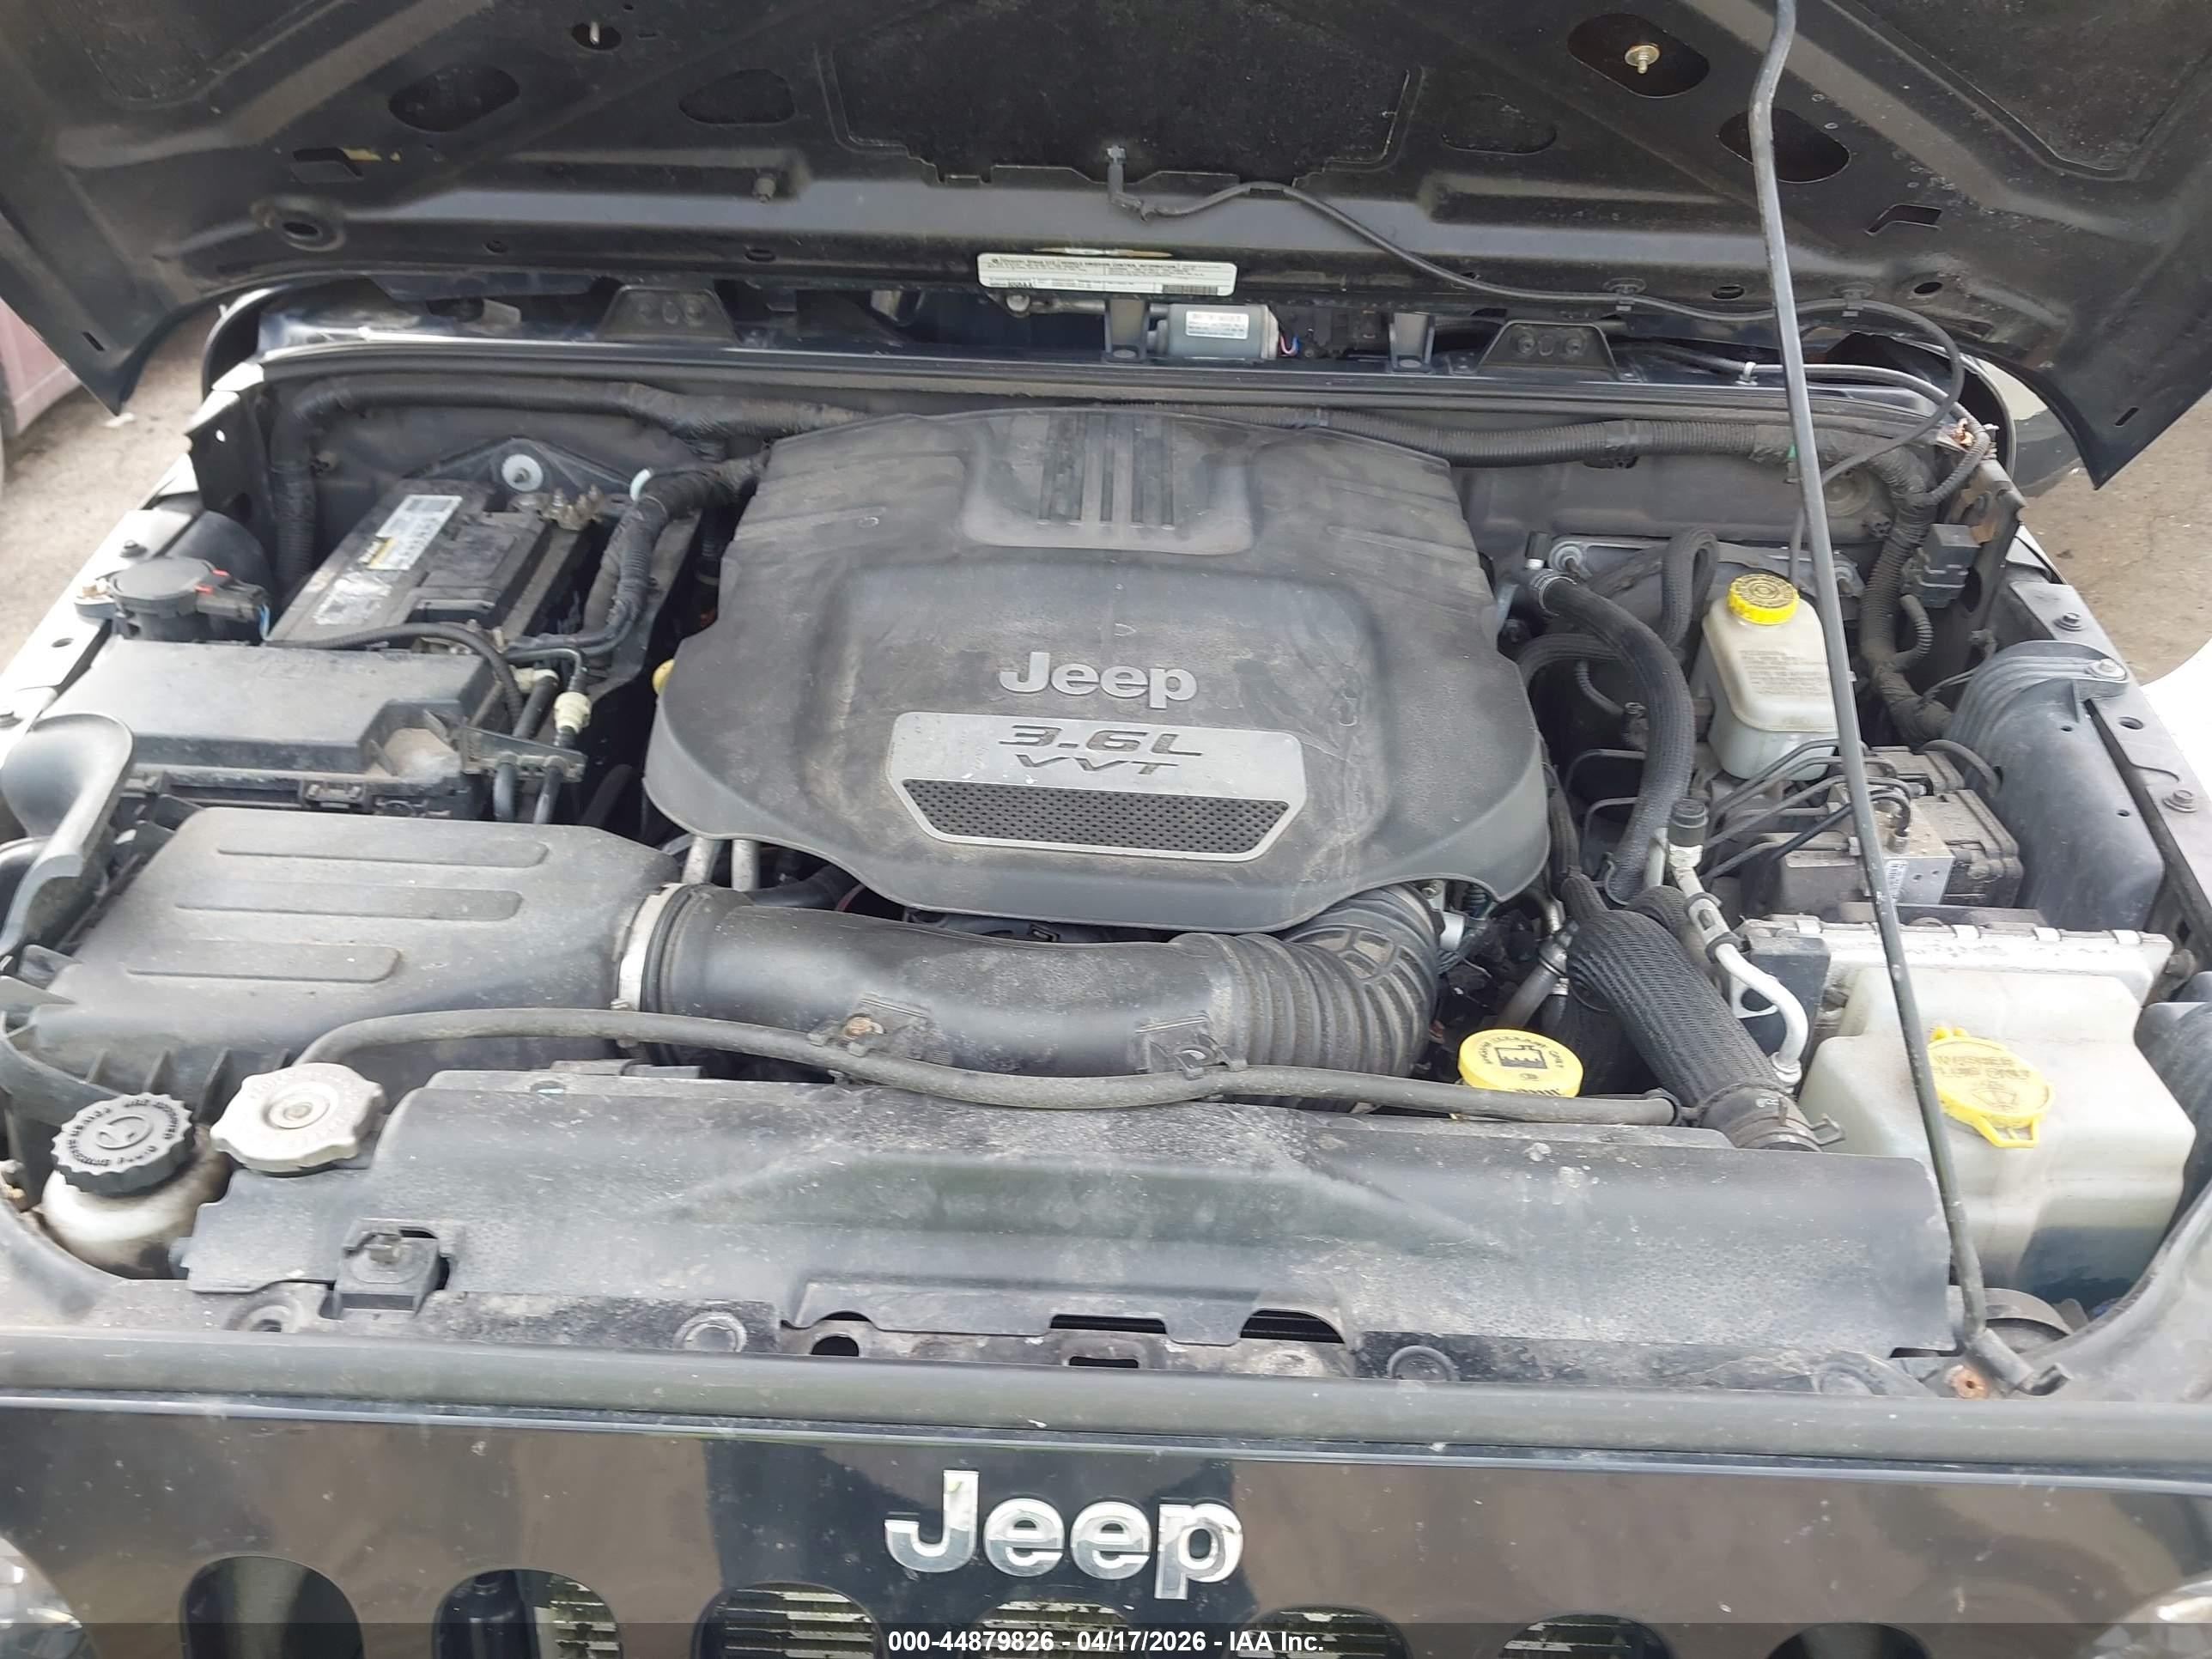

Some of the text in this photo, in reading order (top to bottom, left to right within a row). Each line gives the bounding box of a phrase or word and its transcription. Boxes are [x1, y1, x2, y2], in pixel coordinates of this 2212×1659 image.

[999, 651, 1197, 709] Jeep
[999, 725, 1203, 757] 3.6L
[1016, 753, 1179, 776] VVT
[884, 1469, 1244, 1601] Jeep
